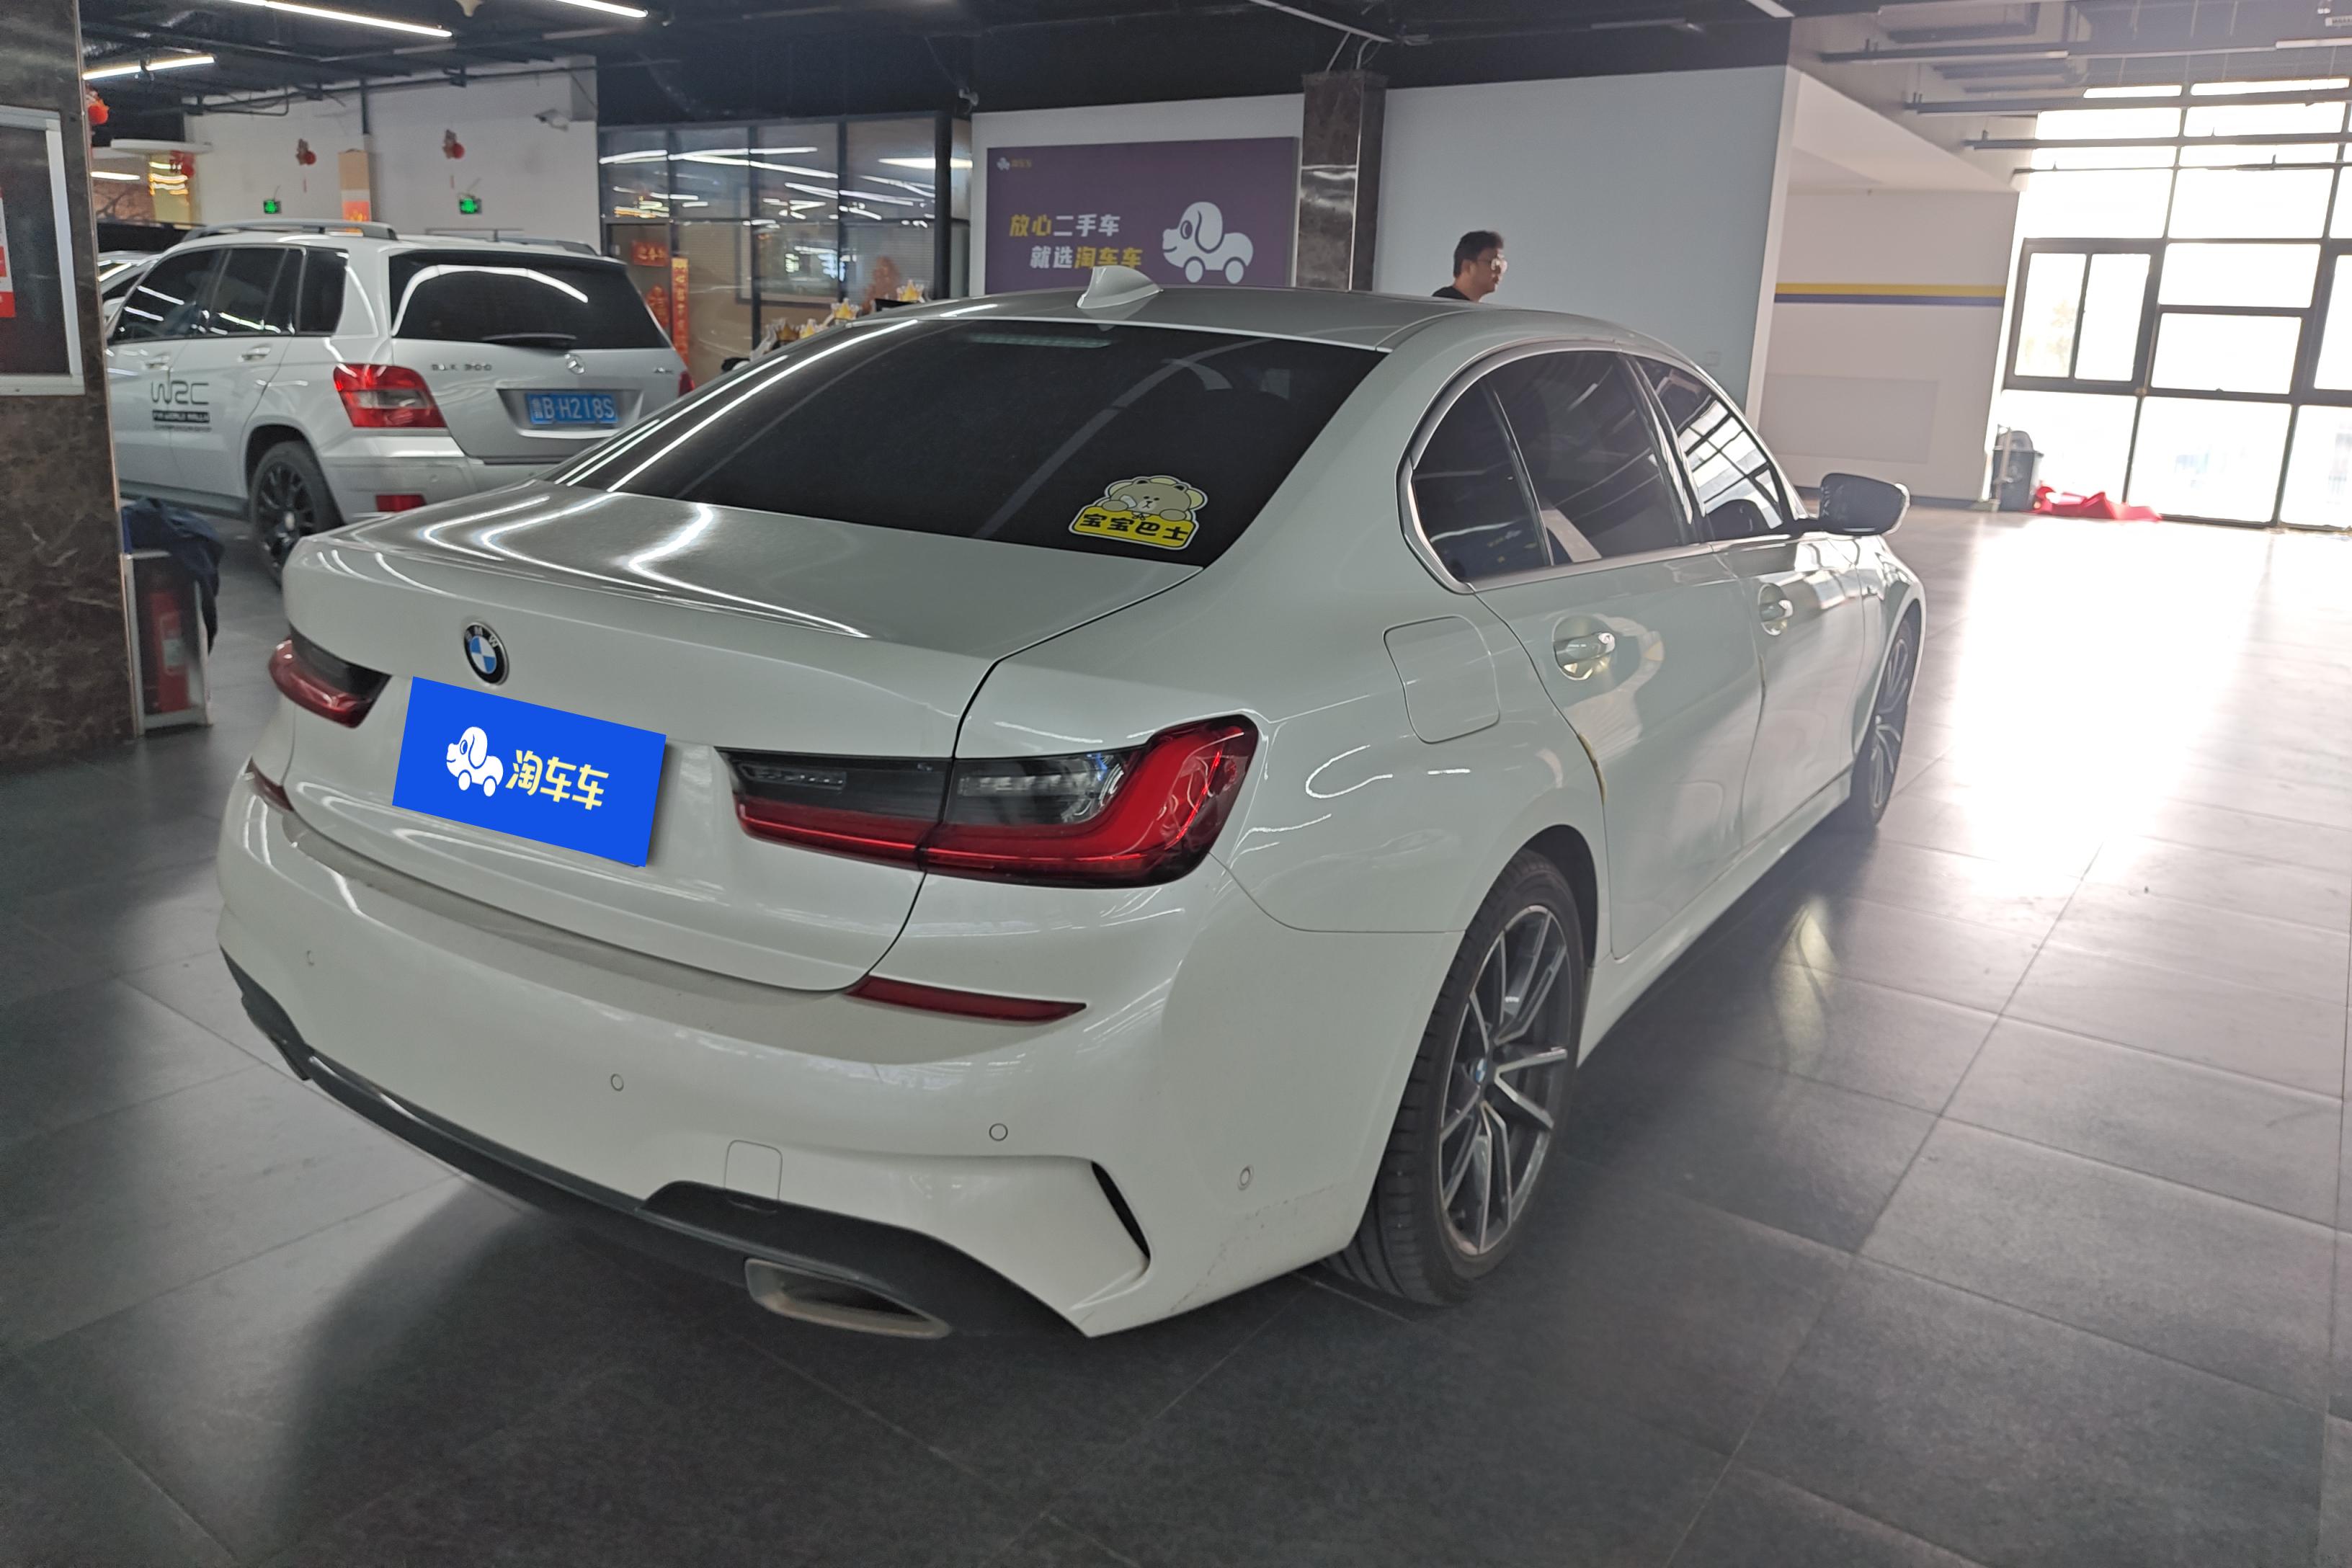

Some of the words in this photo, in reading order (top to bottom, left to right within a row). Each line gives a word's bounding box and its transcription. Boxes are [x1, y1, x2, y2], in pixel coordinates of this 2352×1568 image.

[1010, 214, 1121, 236] 放心二手车
[1030, 246, 1143, 269] 就选淘车车
[1079, 512, 1189, 542] 宝宝巴士
[464, 625, 500, 649] BMW
